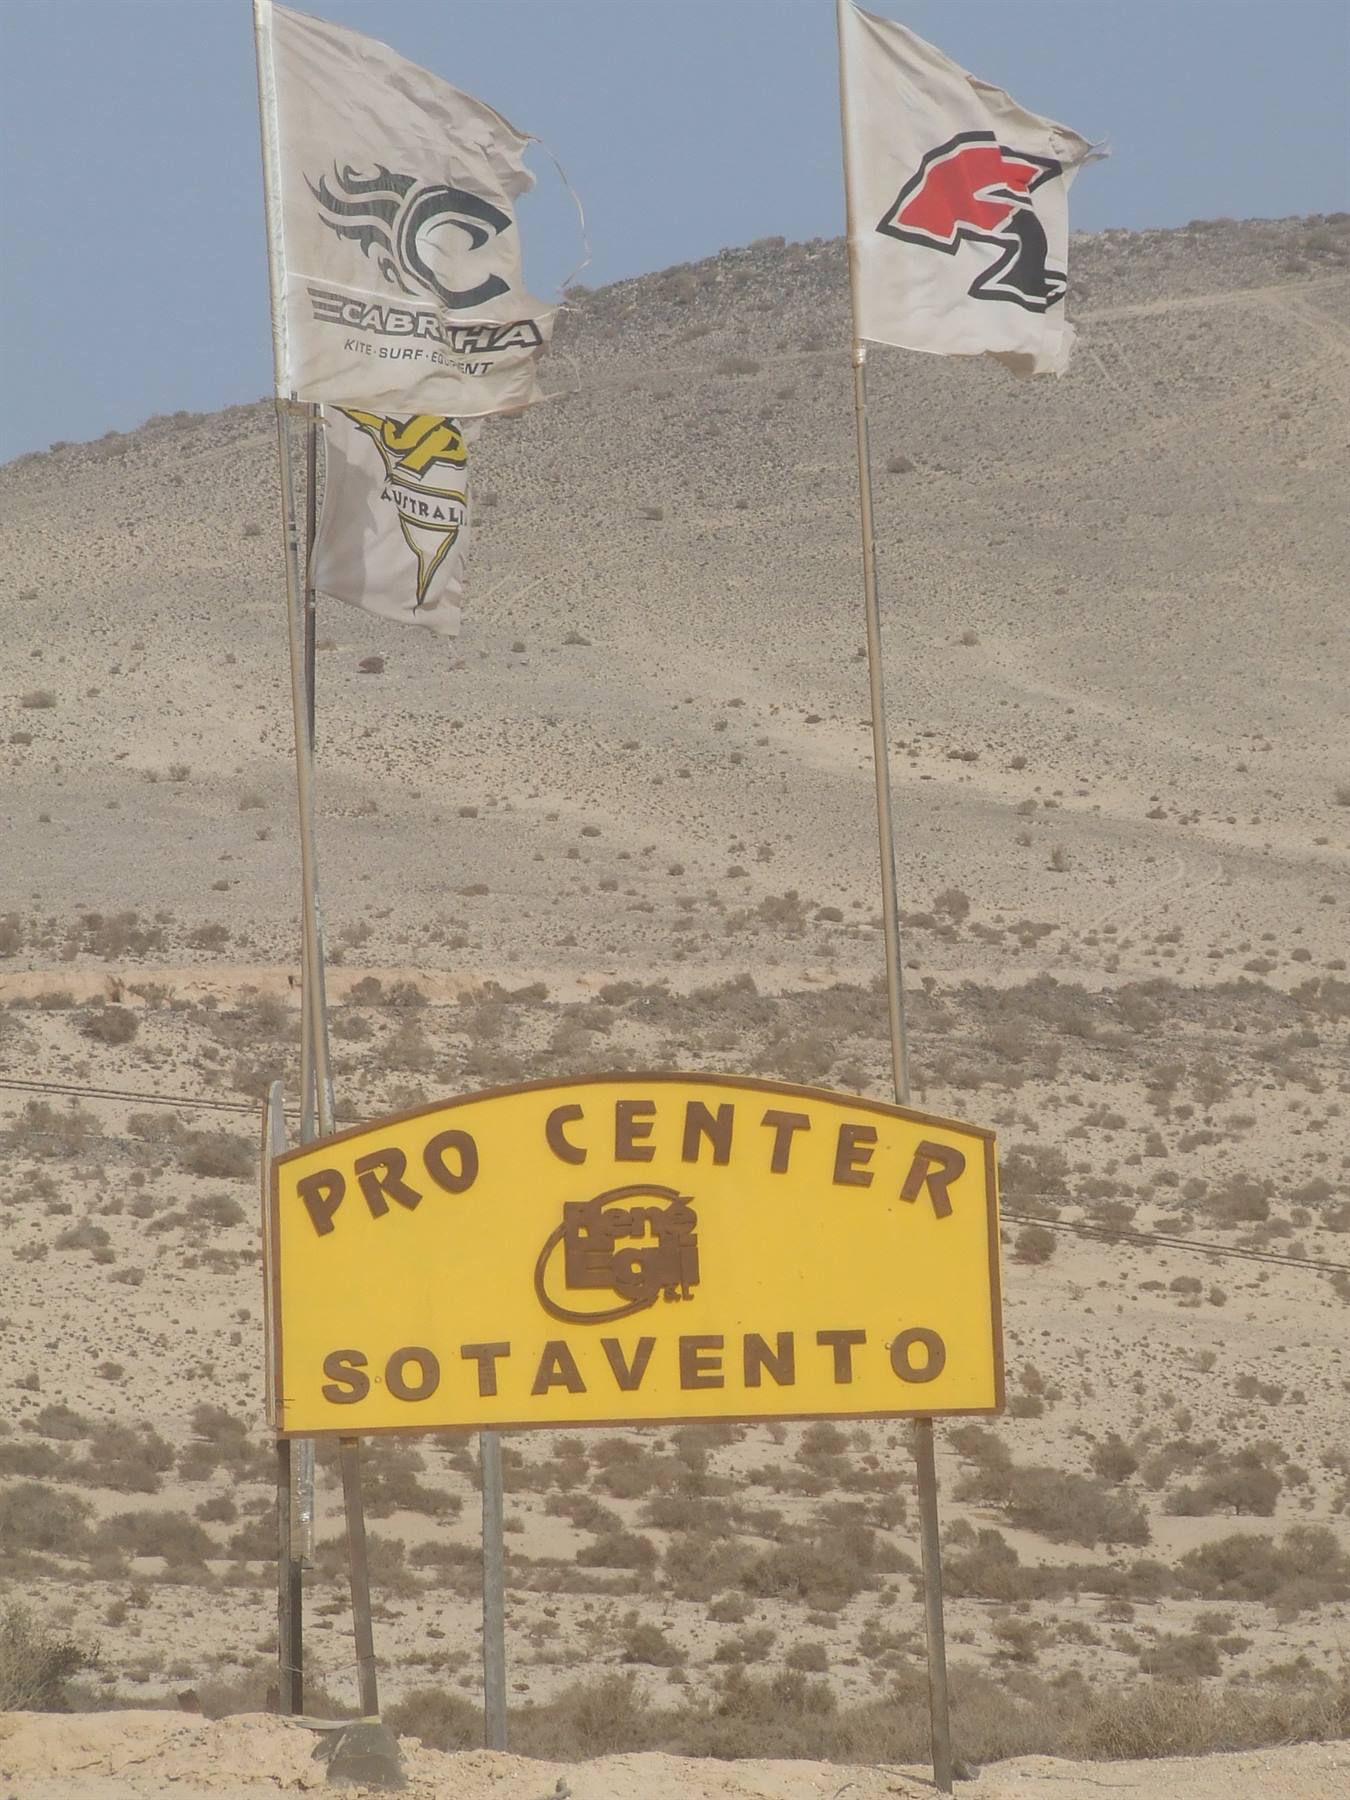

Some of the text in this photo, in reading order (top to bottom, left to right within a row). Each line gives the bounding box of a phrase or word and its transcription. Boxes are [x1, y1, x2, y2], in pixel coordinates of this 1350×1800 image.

[332, 298, 543, 354] CABRHA
[344, 338, 372, 356] KITE
[378, 347, 424, 361] SURF
[380, 487, 467, 526] AUSTRALI
[296, 1099, 967, 1237] PRO CENTER
[321, 1327, 946, 1405] SOTAVENTO
